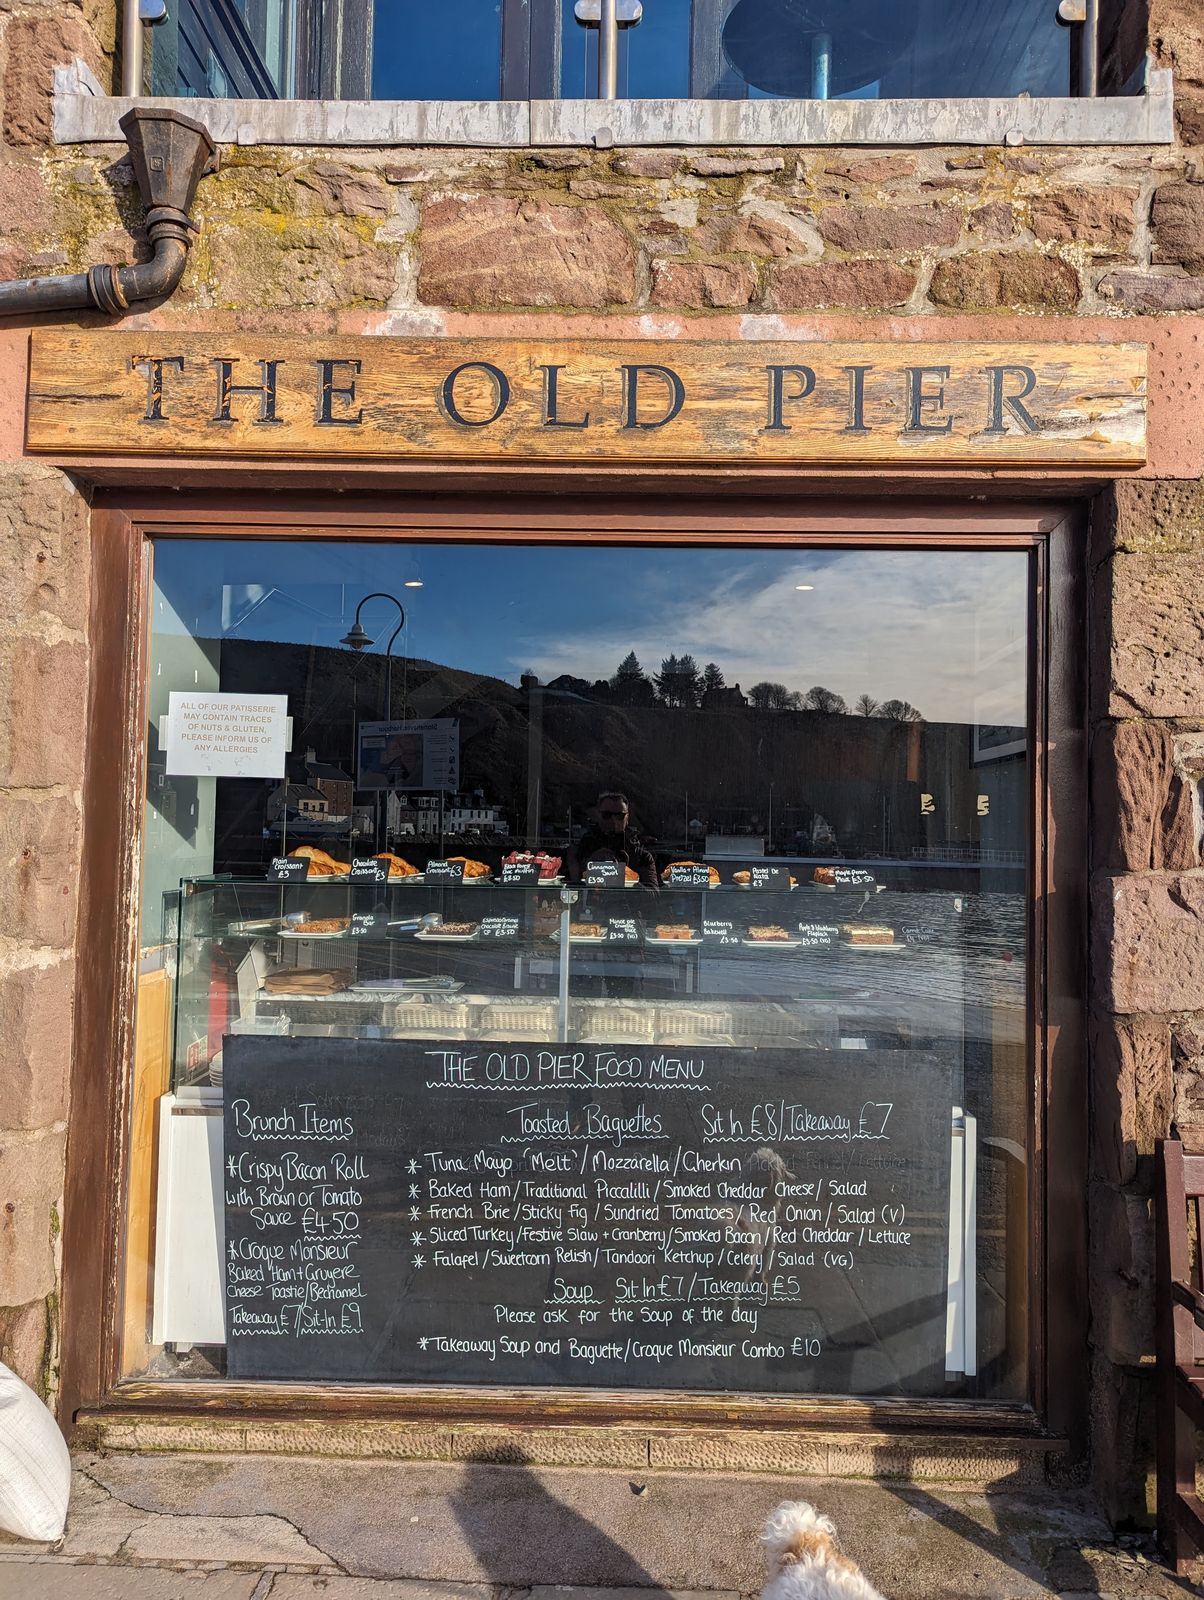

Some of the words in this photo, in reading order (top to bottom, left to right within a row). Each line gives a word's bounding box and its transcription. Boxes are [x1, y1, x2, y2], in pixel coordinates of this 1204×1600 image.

[128, 355, 363, 425] THE
[438, 361, 686, 431] OLD
[763, 364, 1043, 434] PIER
[180, 702, 195, 710] ALL
[211, 703, 229, 711] OUR
[230, 704, 276, 713] PATISSERIE
[183, 712, 201, 720] MAY
[202, 713, 238, 722] CONTAIN
[239, 715, 272, 723] TRACES
[181, 733, 213, 741] PLEASE
[214, 734, 246, 743] INFORM
[248, 735, 259, 743] US
[261, 736, 272, 744] OF
[200, 723, 222, 732] NUTS
[224, 724, 230, 732] &
[232, 724, 267, 734] GLUTEN,
[213, 745, 258, 754] ALLERGIES
[272, 857, 288, 866] Plain
[274, 862, 304, 870] Croissant
[450, 864, 462, 878] £3
[587, 861, 615, 871] Cinnamon
[752, 867, 769, 875] Pastel
[278, 870, 290, 879] £3
[375, 870, 386, 881] £3
[752, 879, 763, 887] £3
[703, 920, 733, 929] Blueberry
[424, 1052, 478, 1082] THE
[485, 1052, 529, 1082] OLD
[537, 1051, 592, 1083] PIER
[650, 1054, 704, 1081] MENU
[232, 1098, 296, 1138] Brunch
[299, 1103, 354, 1136] Items
[507, 1102, 570, 1135] Toasted
[583, 1103, 662, 1148] Baguettes
[701, 1103, 723, 1136] Sit
[729, 1108, 743, 1136] In
[859, 1101, 893, 1134] £7
[238, 1151, 285, 1193] Crispy
[280, 1151, 327, 1182] Bacon
[331, 1152, 370, 1181] Roll
[424, 1151, 469, 1172] Tuna
[474, 1149, 513, 1178] Mayo
[592, 1150, 670, 1173] Mozzarella
[225, 1186, 254, 1207] with
[255, 1185, 296, 1207] Brown
[298, 1191, 315, 1207] or
[312, 1184, 363, 1207] Tomato
[428, 1178, 473, 1199] Baked
[479, 1182, 511, 1199] Ham
[522, 1181, 588, 1199] Traditional
[594, 1178, 651, 1199] Piccalilli
[663, 1179, 711, 1199] Smoked
[716, 1181, 768, 1199] Cheddar
[774, 1181, 815, 1197] Cheese
[828, 1179, 868, 1196] Salad
[250, 1207, 297, 1231] Sauce
[427, 1203, 474, 1220] French
[481, 1201, 511, 1220] Brie
[522, 1203, 562, 1229] Sticky
[567, 1203, 588, 1229] Fig
[603, 1203, 660, 1221] Sundried
[664, 1203, 734, 1220] Tomatoes
[749, 1203, 777, 1223] Red
[785, 1204, 822, 1222] Onion
[837, 1204, 876, 1224] Salad
[881, 1203, 905, 1226] (V)
[429, 1226, 468, 1244] Sliced
[468, 1225, 514, 1252] Turkey
[567, 1227, 598, 1242] Slaw
[724, 1225, 762, 1244] Bacon
[772, 1225, 797, 1244] Red
[802, 1226, 854, 1244] Cheddar
[868, 1228, 911, 1245] Lettuce
[239, 1237, 286, 1271] Croque
[290, 1239, 358, 1262] Monsieur
[432, 1250, 479, 1270] Falafel
[491, 1249, 550, 1267] Sweetcorn
[600, 1248, 656, 1265] Tandoori
[664, 1249, 714, 1269] Ketchup
[726, 1249, 763, 1274] Celery
[777, 1251, 815, 1267] Salad
[823, 1250, 854, 1270] (VG)
[227, 1262, 265, 1284] Baked
[226, 1285, 264, 1298] Cheese
[553, 1277, 593, 1305] Soup
[615, 1277, 639, 1299] Sit
[643, 1277, 656, 1298] In
[657, 1274, 684, 1297] £7
[697, 1277, 769, 1307] Takeaway
[771, 1275, 801, 1295] £5
[228, 1304, 280, 1334] Takeaway
[341, 1302, 362, 1329] £9
[493, 1304, 537, 1324] Please
[543, 1308, 570, 1324] ask
[577, 1309, 601, 1325] for
[608, 1307, 635, 1323] the
[640, 1306, 673, 1327] Soup
[682, 1307, 695, 1325] of
[701, 1306, 724, 1322] the
[731, 1307, 758, 1334] day
[428, 1336, 496, 1361] Takeaway
[500, 1335, 530, 1358] Soup
[535, 1339, 560, 1355] and
[678, 1338, 737, 1358] Monsieur
[741, 1339, 785, 1359] Combo
[790, 1336, 821, 1357] £10
